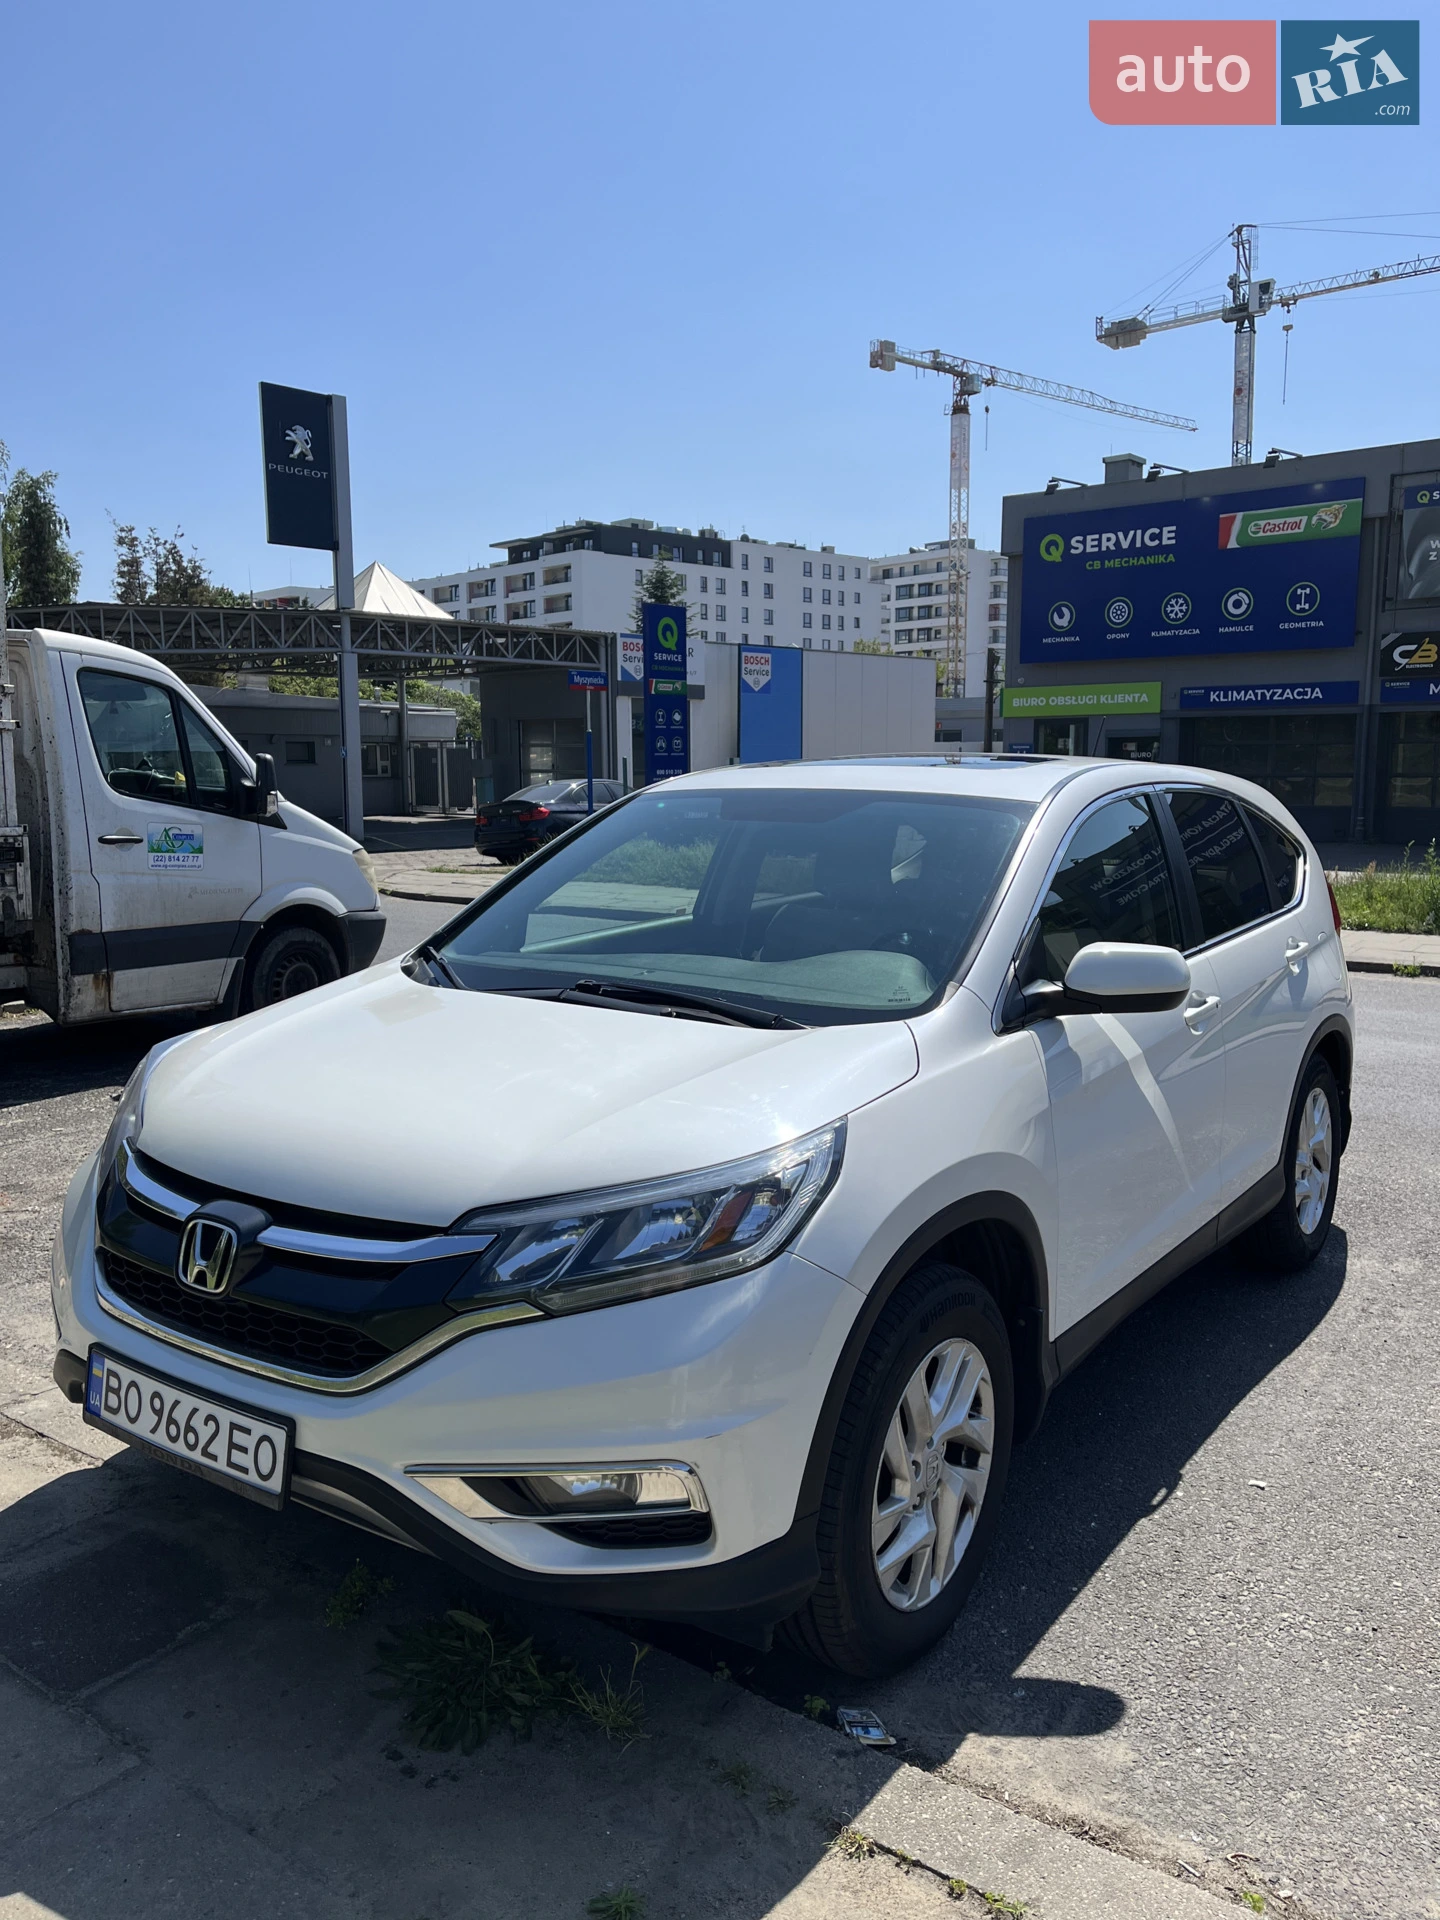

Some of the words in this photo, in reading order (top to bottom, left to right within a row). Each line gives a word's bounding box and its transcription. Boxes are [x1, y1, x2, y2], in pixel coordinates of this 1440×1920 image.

[268, 463, 329, 479] PEUGEOT
[952, 523, 957, 533] 5
[962, 522, 967, 533] 5
[1262, 519, 1302, 534] Castrol
[1039, 533, 1065, 562] Q
[1070, 525, 1177, 555] SERVICE
[1086, 560, 1101, 570] CB
[1104, 553, 1175, 569] MECHANIKA
[1218, 625, 1254, 633] HAMULCE
[1279, 620, 1324, 629] GEOMETRIA
[1151, 628, 1200, 637] KLIMATYZACJA
[1042, 635, 1080, 644] MECHANIKA
[654, 653, 682, 662] SERVICE
[744, 655, 770, 666] BOSCH
[743, 667, 770, 676] Service
[1012, 697, 1046, 707] BIURO
[1049, 695, 1097, 706] OBSŁUGI
[1099, 693, 1149, 704] KLIENTA
[1210, 688, 1323, 702] KLIMATYZACJA
[153, 855, 166, 863] (22)
[167, 855, 180, 863] 814
[181, 855, 190, 863] 27
[191, 855, 200, 863] 77
[90, 1391, 101, 1406] UA
[103, 1368, 142, 1424] BO
[149, 1391, 220, 1463] 9662
[226, 1421, 277, 1482] EO
